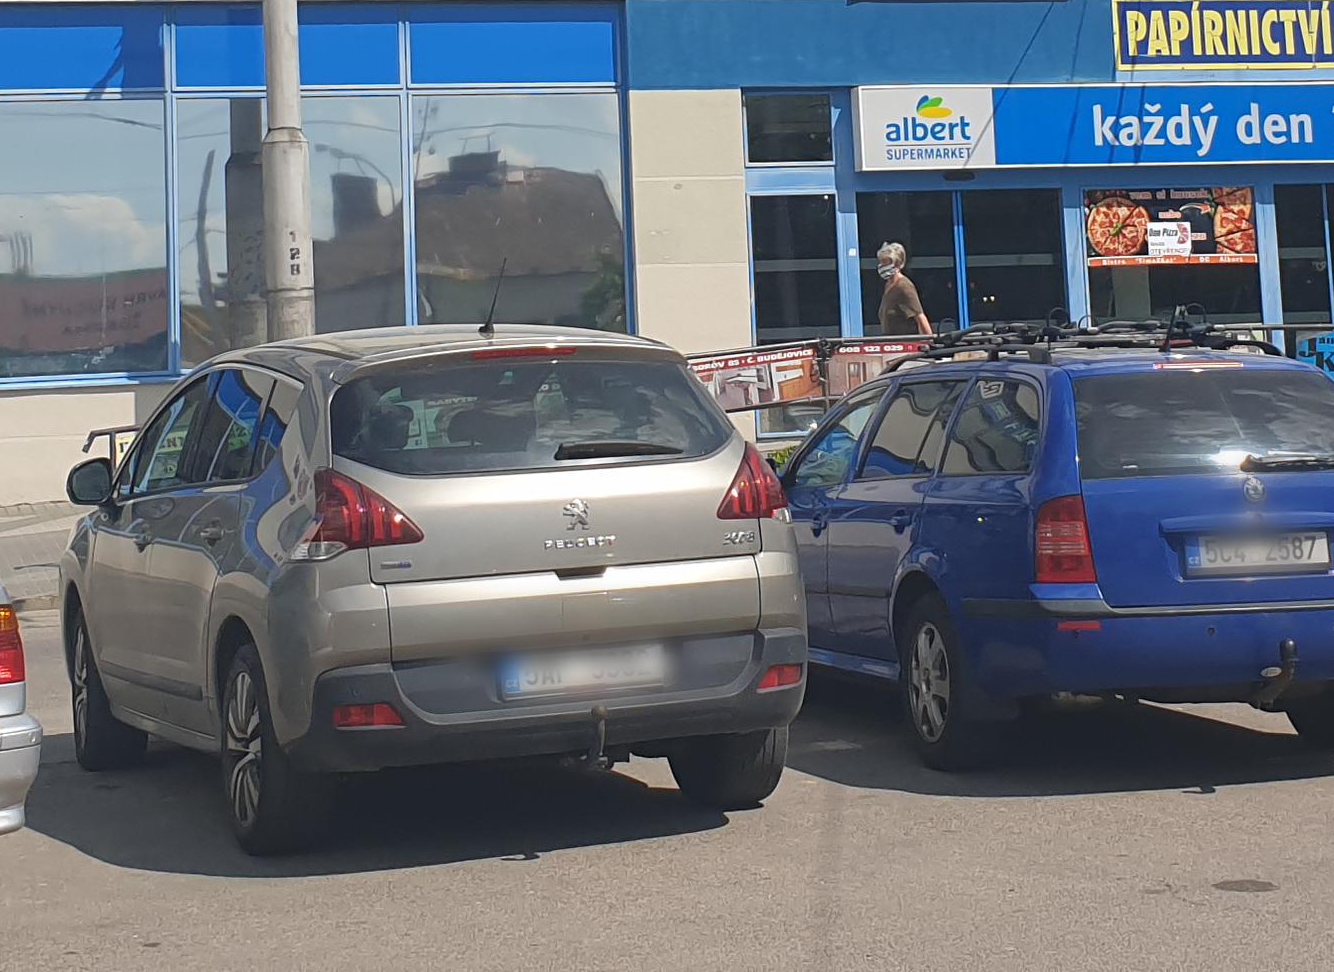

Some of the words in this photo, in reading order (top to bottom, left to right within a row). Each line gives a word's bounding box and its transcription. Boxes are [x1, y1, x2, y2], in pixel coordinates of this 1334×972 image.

[1126, 1, 1334, 56] PAPÍRNICTVÍ
[886, 116, 971, 142] albert
[1093, 103, 1217, 156] každý
[1236, 102, 1314, 145] den
[887, 147, 971, 160] SUPERMARKET
